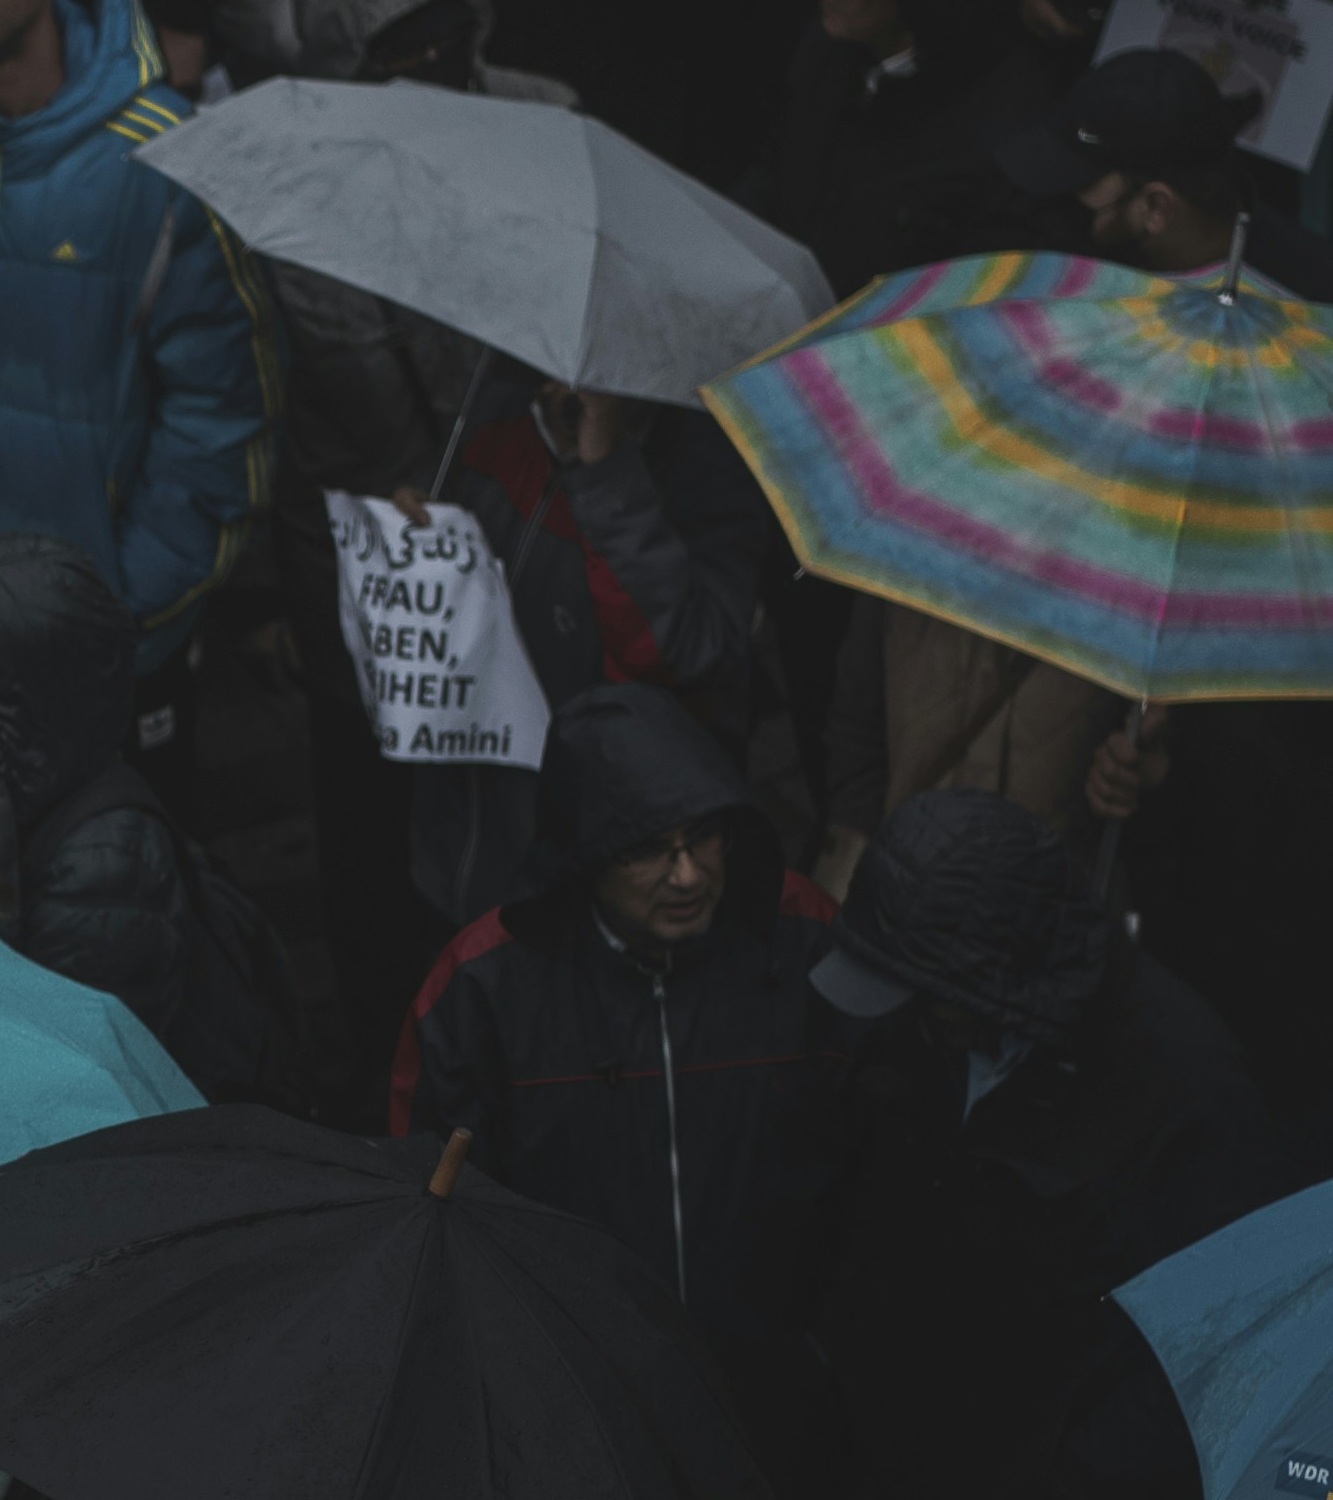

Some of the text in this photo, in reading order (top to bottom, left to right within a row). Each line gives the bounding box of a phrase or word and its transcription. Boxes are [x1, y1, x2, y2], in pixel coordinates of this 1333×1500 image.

[359, 572, 454, 622] FRAU,
[367, 622, 458, 669] BEN,
[365, 660, 475, 709] IHEIT
[410, 721, 511, 756] Amini
[1288, 1459, 1330, 1486] WDR
